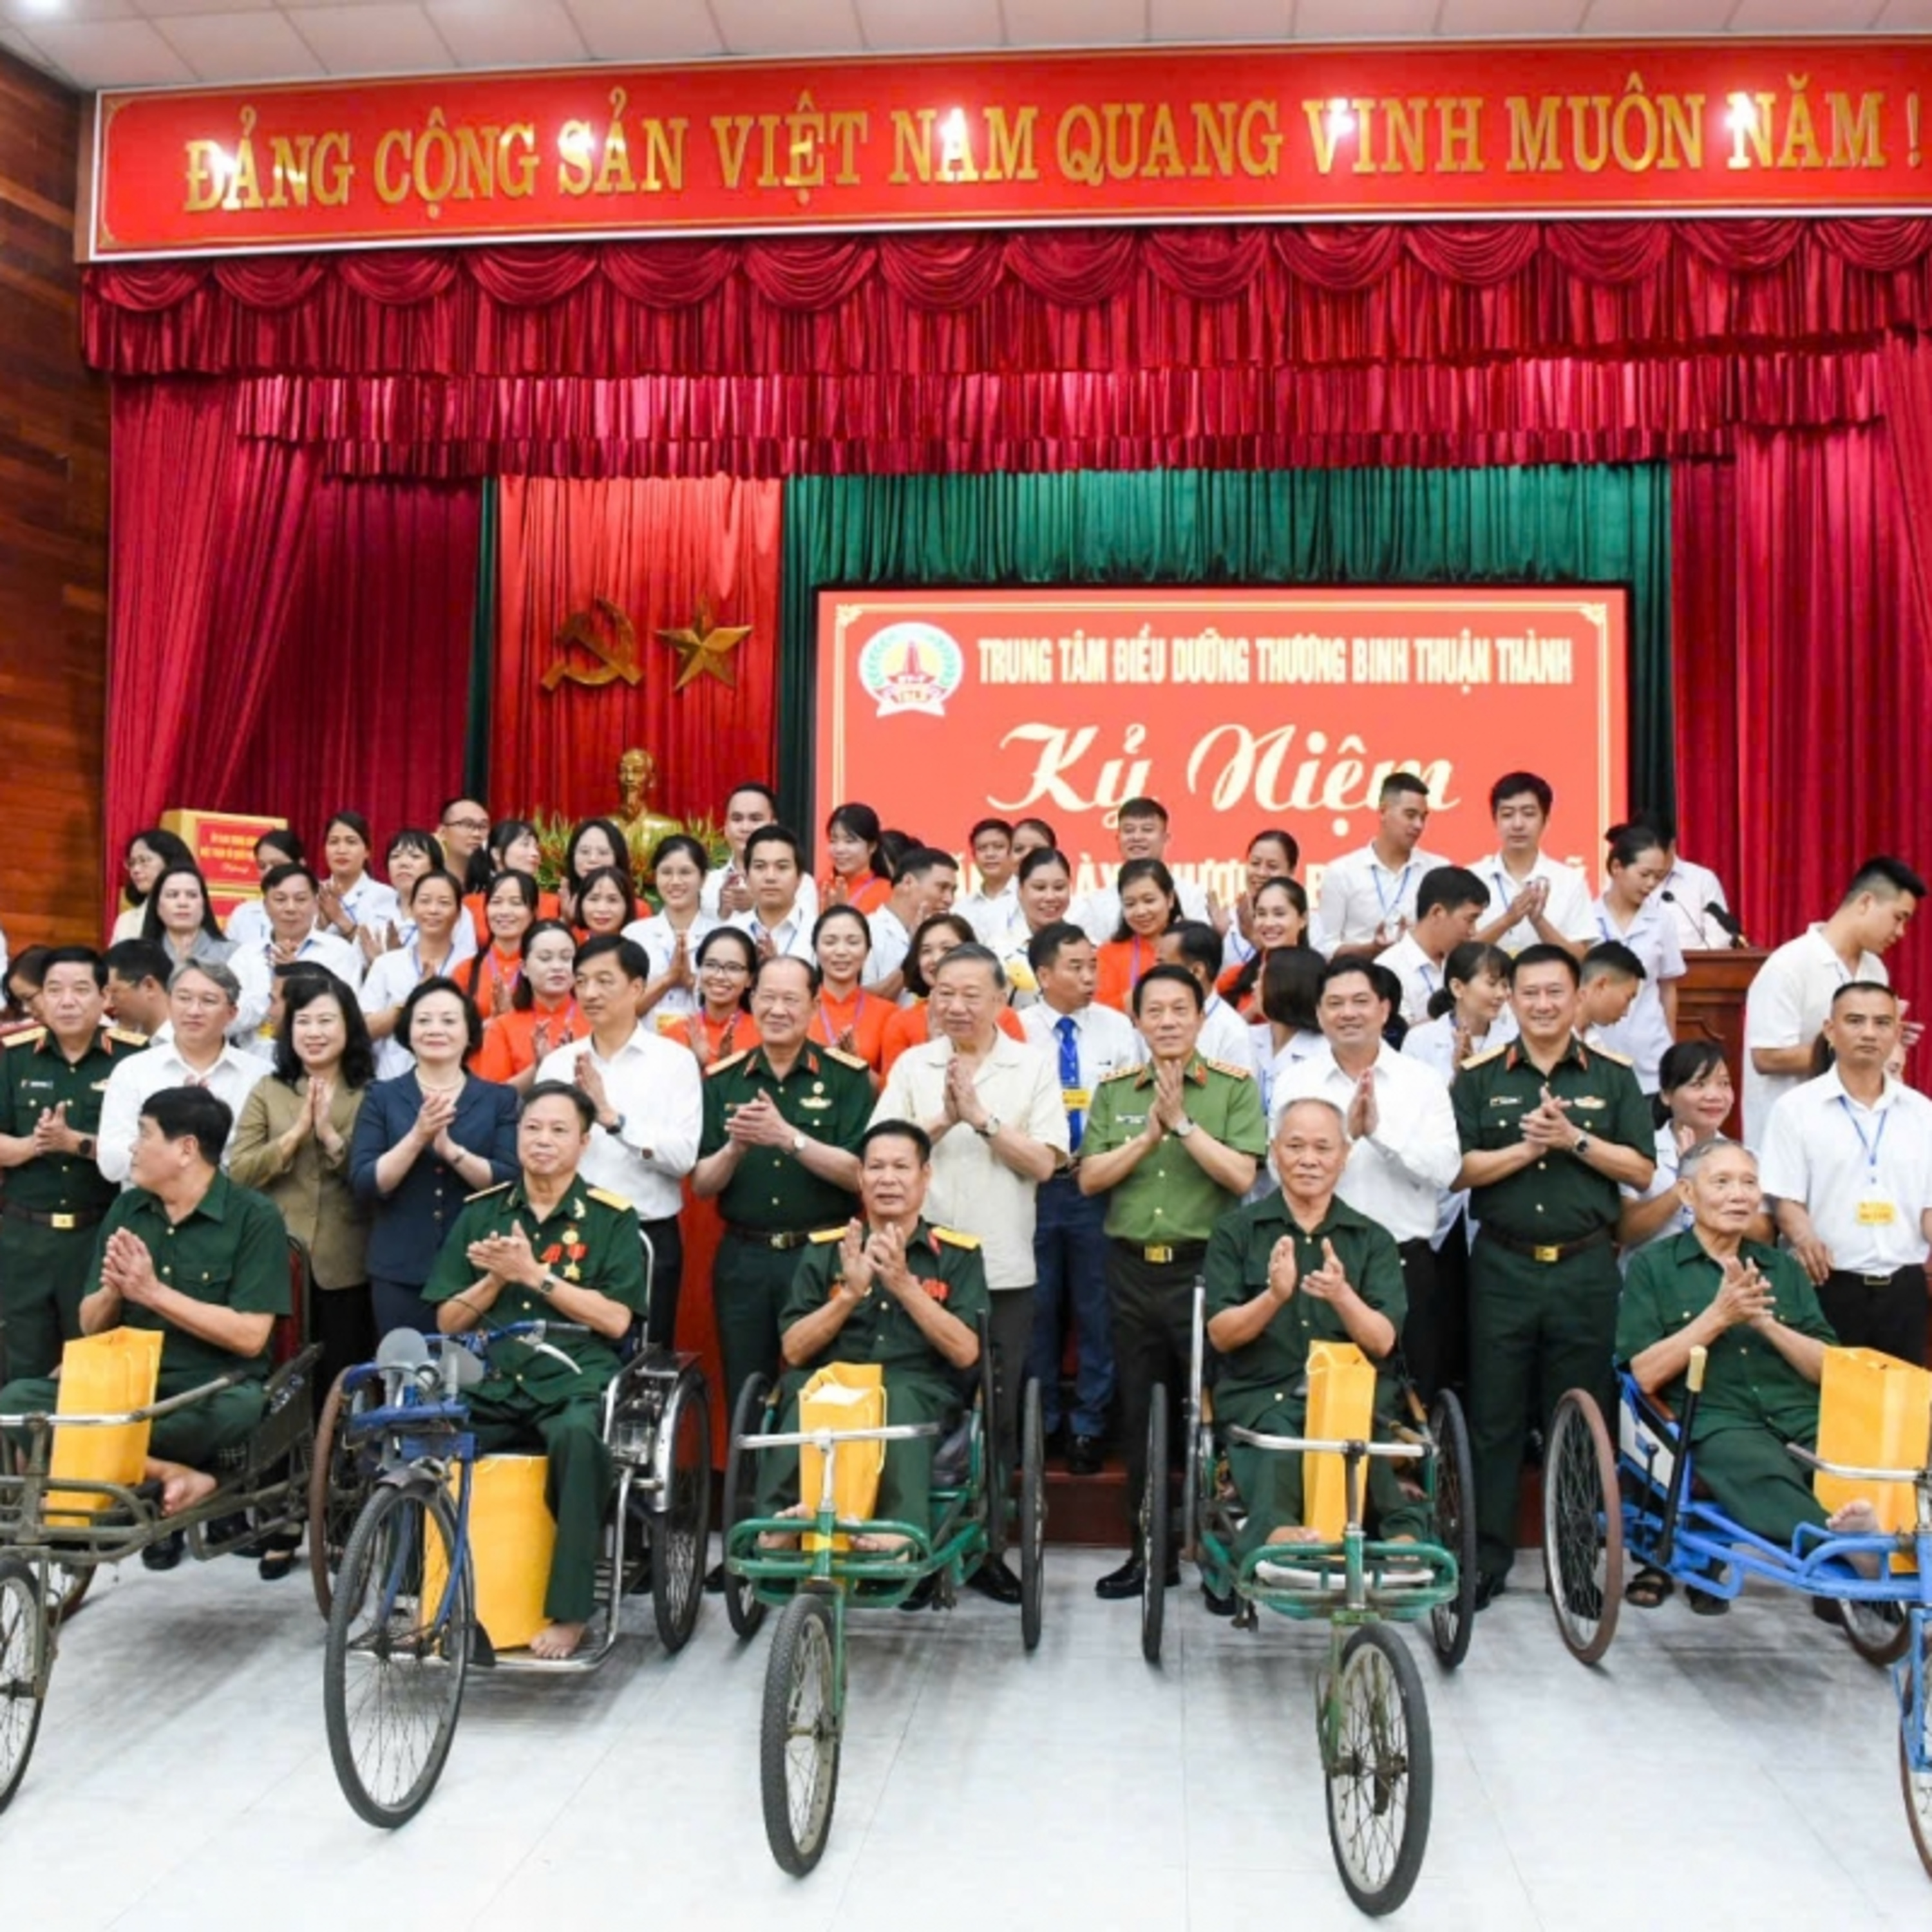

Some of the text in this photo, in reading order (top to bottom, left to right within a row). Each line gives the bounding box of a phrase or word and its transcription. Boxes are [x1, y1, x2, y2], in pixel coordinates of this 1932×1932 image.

[184, 105, 354, 212] ĐẢNG
[374, 106, 541, 219] CỘNG
[557, 86, 688, 196] SẢN
[711, 90, 867, 205] VIỆT
[889, 102, 1039, 184] NAM
[1057, 100, 1283, 186] QUANG
[1302, 94, 1484, 175] VINH
[1506, 71, 1706, 172] MUÔN
[1726, 73, 1884, 170] NĂM
[978, 638, 1053, 684] TRUNG
[1058, 629, 1108, 683] TÂM
[1171, 627, 1250, 683] DƯỠNG
[1255, 634, 1347, 683] THƯƠNG
[1352, 638, 1410, 683] BINH
[1413, 629, 1491, 694] THUẬN
[1495, 629, 1573, 684] THÀNH
[987, 722, 1461, 837] Kỷ Niệm
